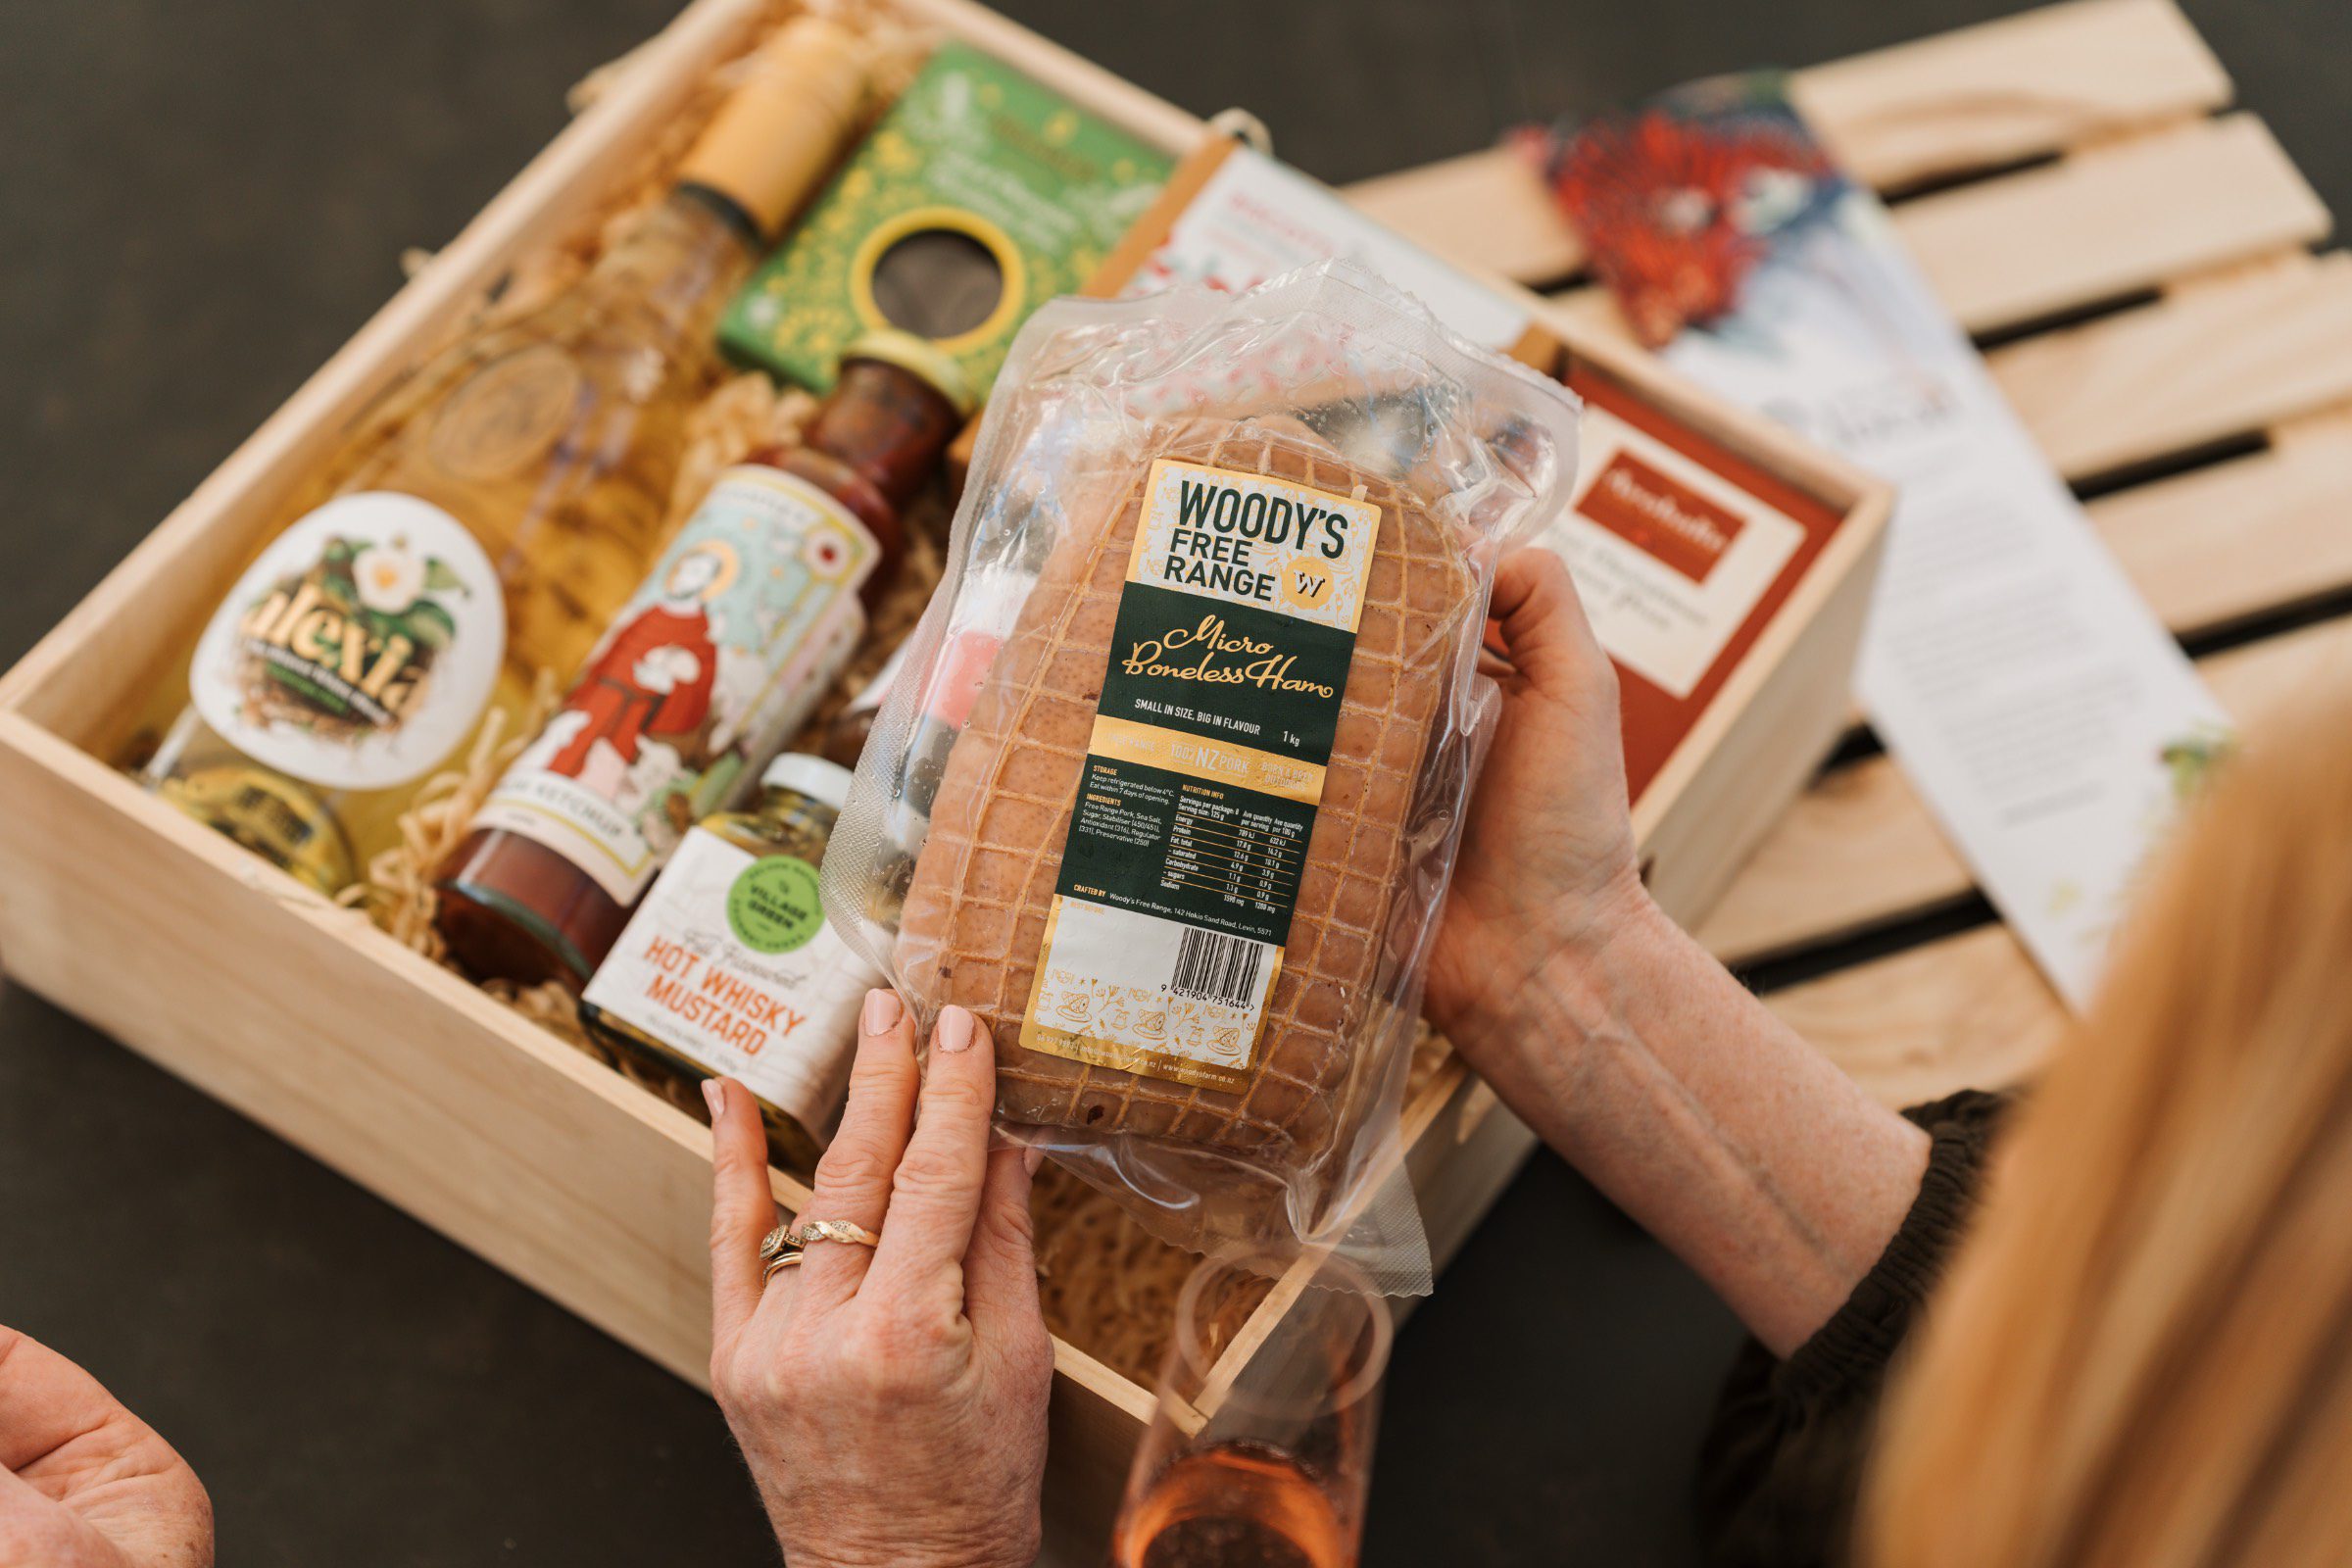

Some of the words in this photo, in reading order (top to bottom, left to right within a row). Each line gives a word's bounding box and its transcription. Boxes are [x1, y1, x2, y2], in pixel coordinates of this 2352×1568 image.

[1178, 480, 1348, 559] WOODY'S
[1170, 528, 1253, 566] FREE
[1163, 556, 1276, 602] RANGE
[1163, 614, 1274, 656] Micro
[1122, 640, 1245, 684] Boneless
[1245, 655, 1334, 699] Ham
[1135, 699, 1162, 712] SMALL
[1164, 705, 1174, 714] IN
[1175, 707, 1195, 720] SIZE,
[1197, 711, 1211, 723] BIG
[1213, 715, 1222, 726] IN
[1223, 718, 1260, 735] FLAVOUR
[1284, 731, 1288, 742] 1
[1290, 734, 1300, 747] kg
[1194, 746, 1219, 771] NZ
[1218, 755, 1250, 773] PORK
[1094, 765, 1117, 775] STORAGE
[1092, 774, 1107, 783] Keep
[1107, 778, 1144, 790] refrigerated
[1144, 785, 1161, 794] below
[1183, 785, 1210, 796] NUTRITION
[1087, 794, 1121, 806] INGREDIENTS
[1123, 789, 1138, 798] days
[1145, 795, 1169, 806] opening.
[1180, 796, 1201, 807] Servings
[1100, 805, 1118, 815] Range
[1136, 812, 1149, 821] Sea
[1178, 804, 1198, 814] Serving
[1102, 813, 1131, 825] Stabiliser
[1176, 814, 1193, 825] Energy
[1250, 821, 1269, 832] serving
[1253, 814, 1273, 824] quantity
[1081, 817, 1114, 830] Antioxidant
[1131, 829, 1160, 840] Regulator
[1096, 829, 1133, 843] Preservative
[1173, 825, 1191, 835] Protein
[1173, 850, 1197, 859] saturated
[1165, 858, 1199, 871] Carbohydrate
[1167, 871, 1185, 880] sugars
[1160, 880, 1180, 890] Sodium
[749, 884, 808, 921] VILLAGE
[1074, 885, 1098, 895] CRAFTED
[1110, 893, 1135, 905] Woody's
[1136, 899, 1151, 907] Free
[1152, 903, 1172, 913] Range,
[1186, 910, 1203, 920] Hokio
[1204, 914, 1220, 924] Sand
[1220, 918, 1238, 929] Road,
[1238, 923, 1256, 933] Levin,
[1257, 927, 1272, 936] 5571
[643, 935, 701, 979] HOT
[701, 965, 807, 1038] WHISKY
[1160, 984, 1166, 993] 9
[1172, 988, 1207, 1002] 421904
[1212, 995, 1247, 1010] 751644
[644, 975, 767, 1056] MUSTARD
